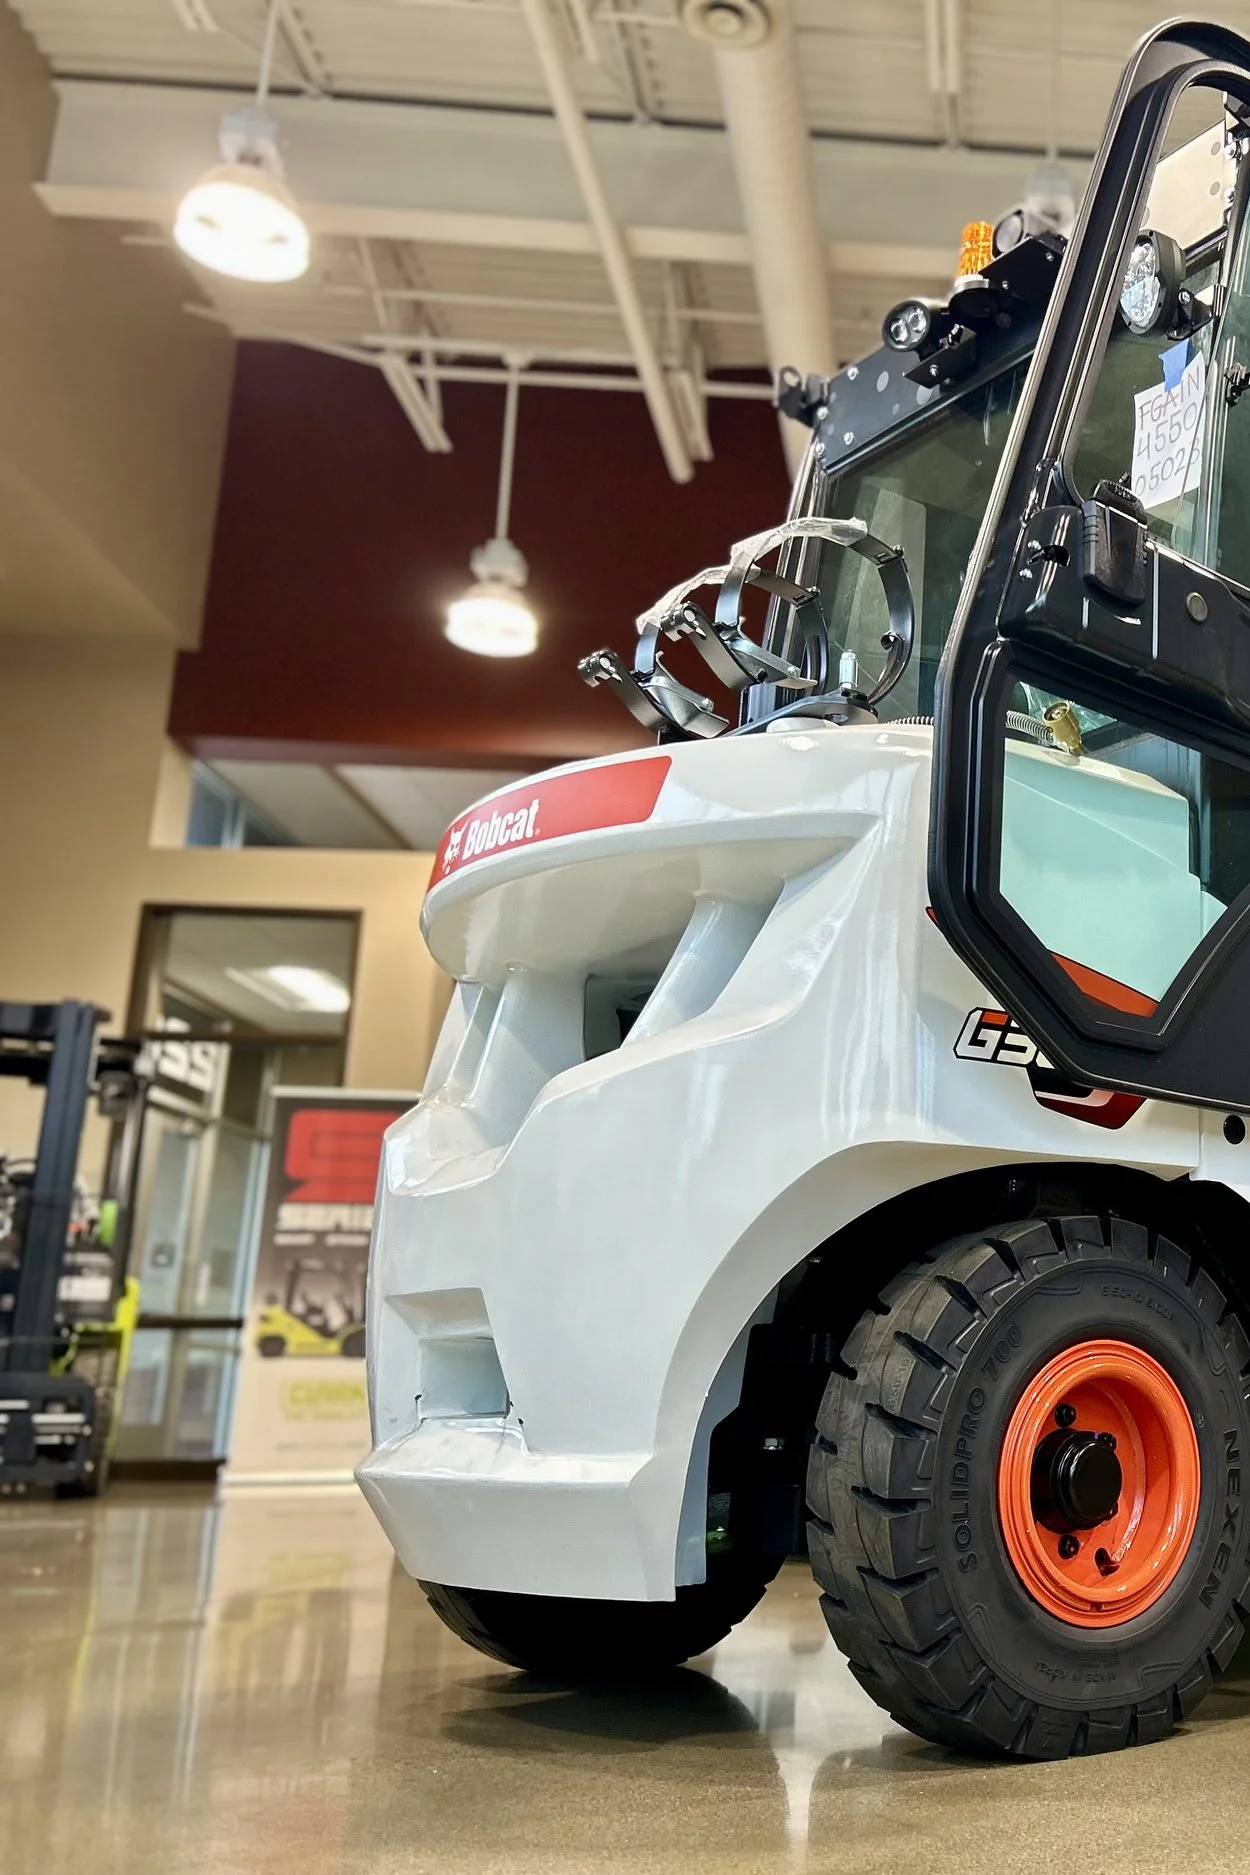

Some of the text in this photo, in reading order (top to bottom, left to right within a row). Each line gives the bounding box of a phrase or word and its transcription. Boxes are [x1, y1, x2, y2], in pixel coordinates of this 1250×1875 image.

[1137, 402, 1197, 460] 4550
[462, 799, 540, 861] Bobcat
[948, 1323, 1023, 1575] SOLIDPRO 700
[1198, 1428, 1242, 1610] NEXEN
